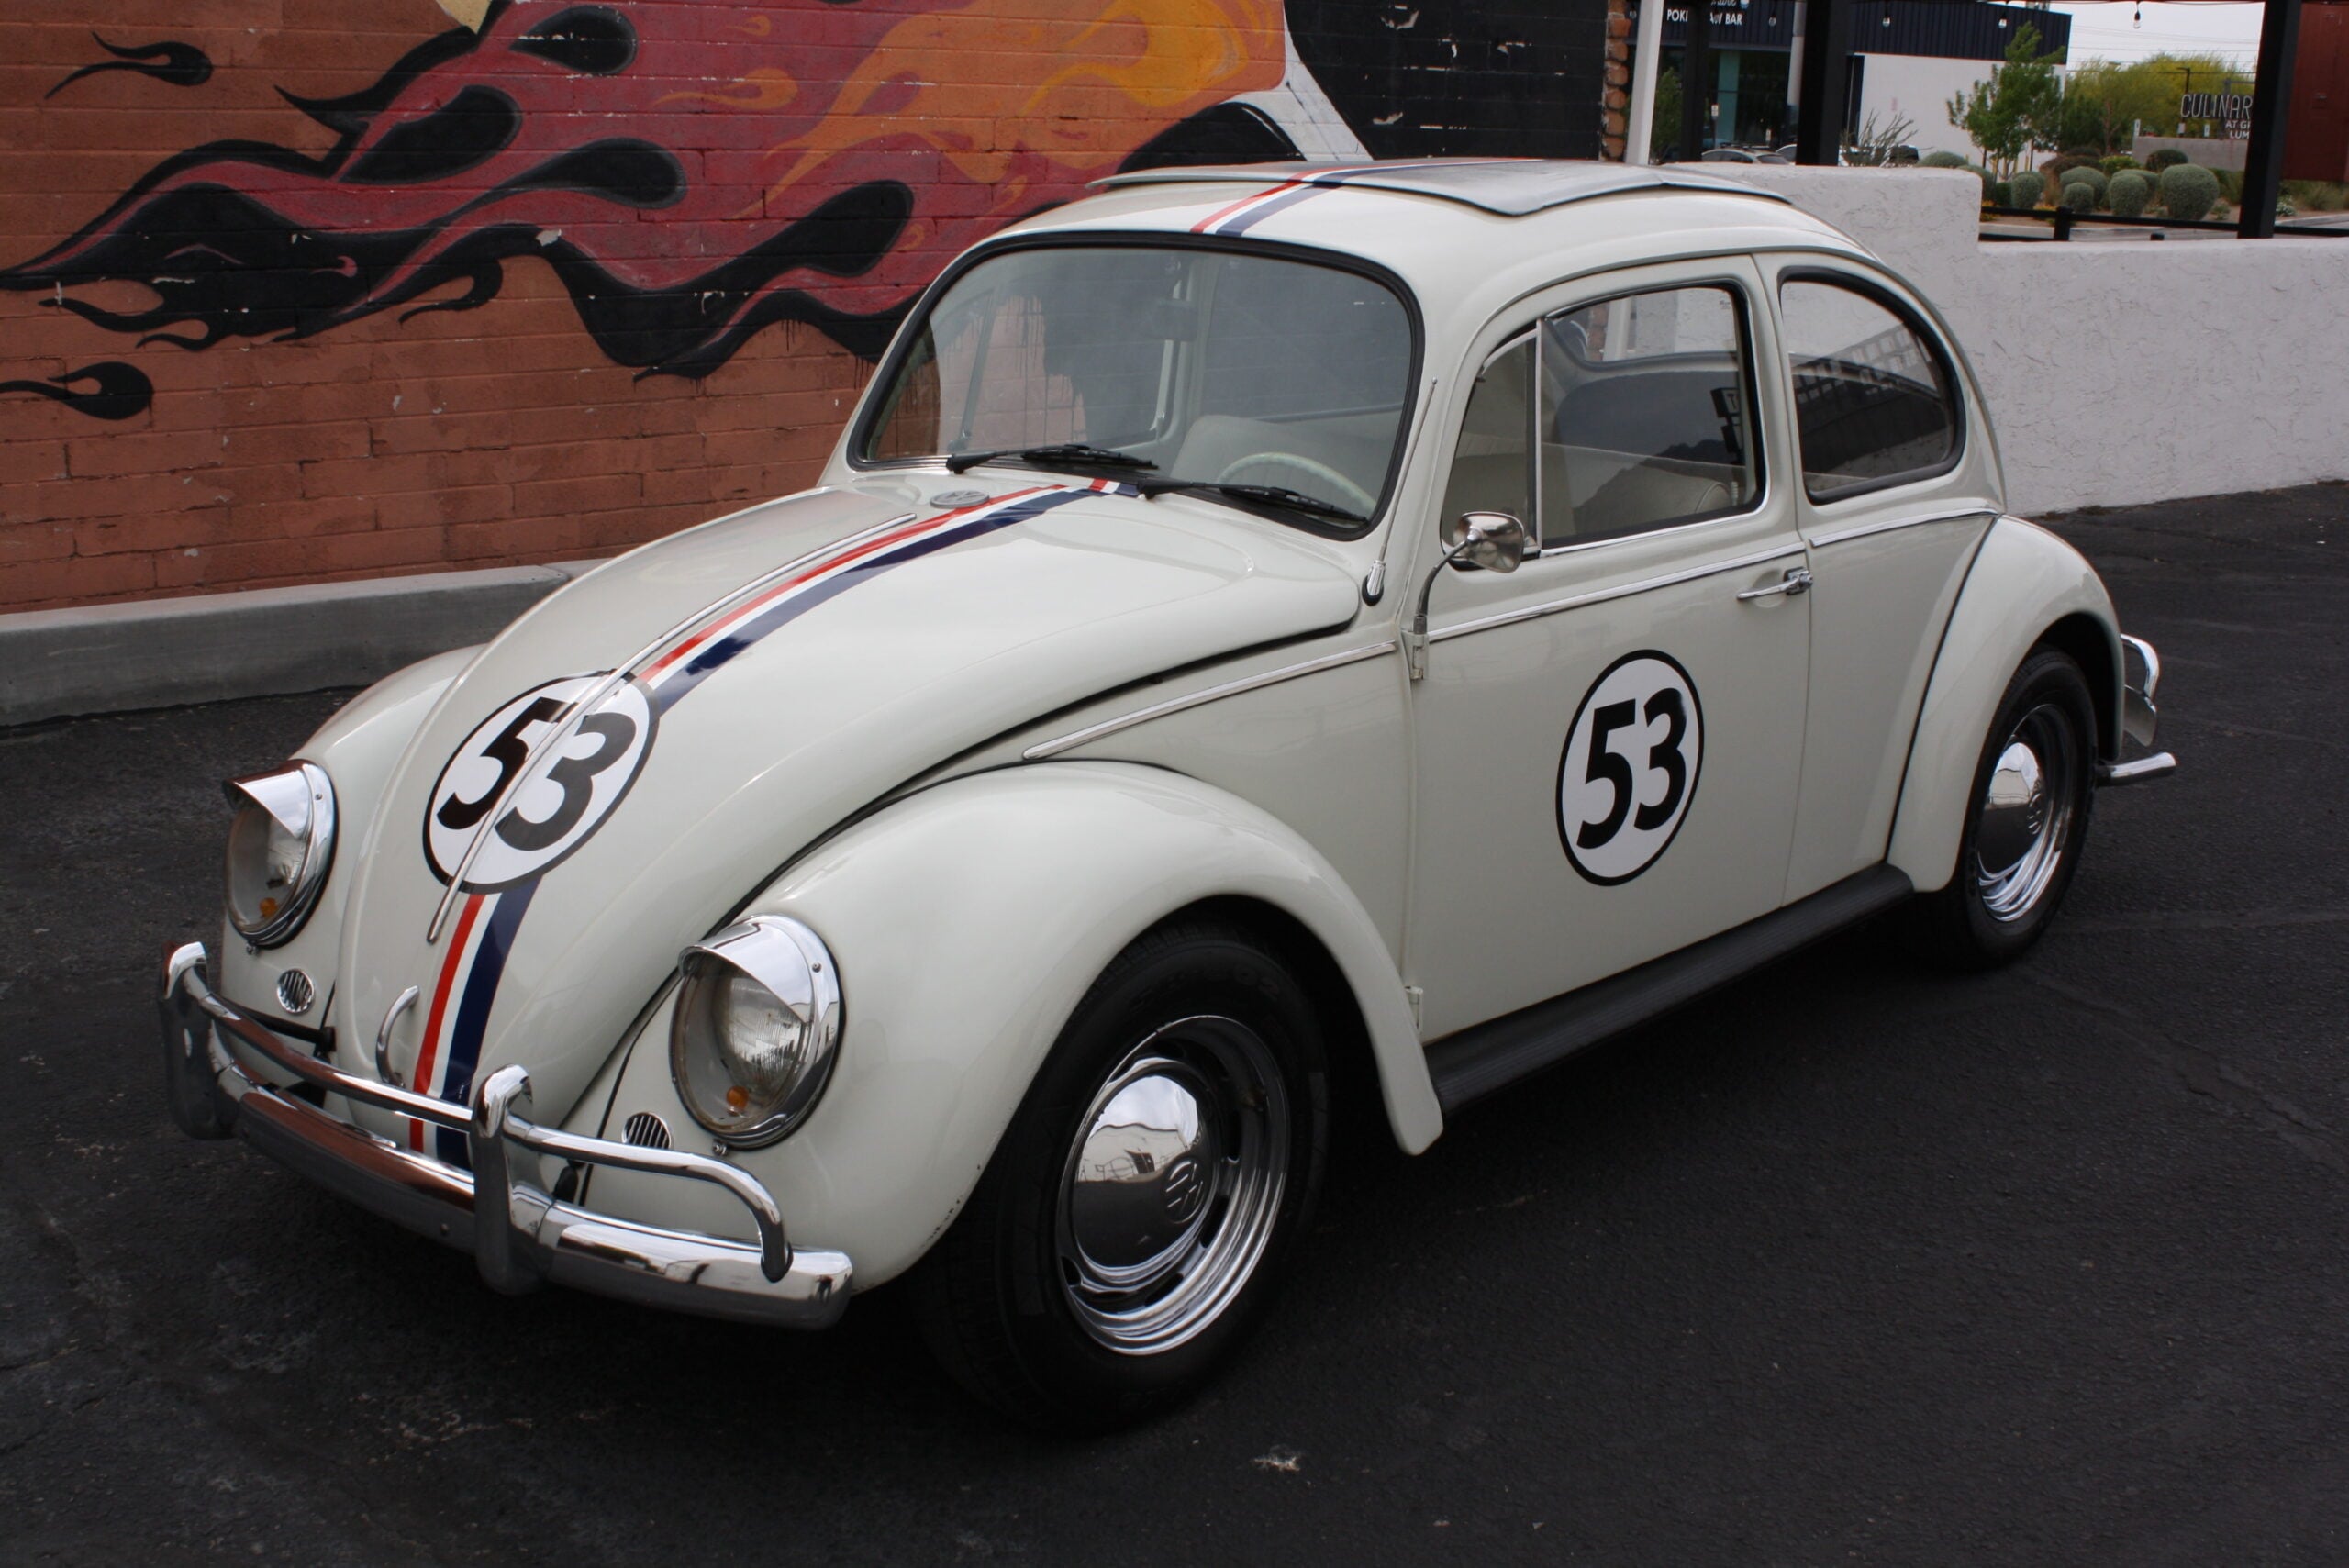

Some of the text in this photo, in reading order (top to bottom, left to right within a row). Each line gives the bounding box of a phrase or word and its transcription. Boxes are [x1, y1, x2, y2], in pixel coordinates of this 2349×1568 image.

[1725, 13, 1743, 26] BAR
[2225, 120, 2238, 128] AT
[437, 696, 637, 851] 53
[1576, 687, 1687, 850] 53
